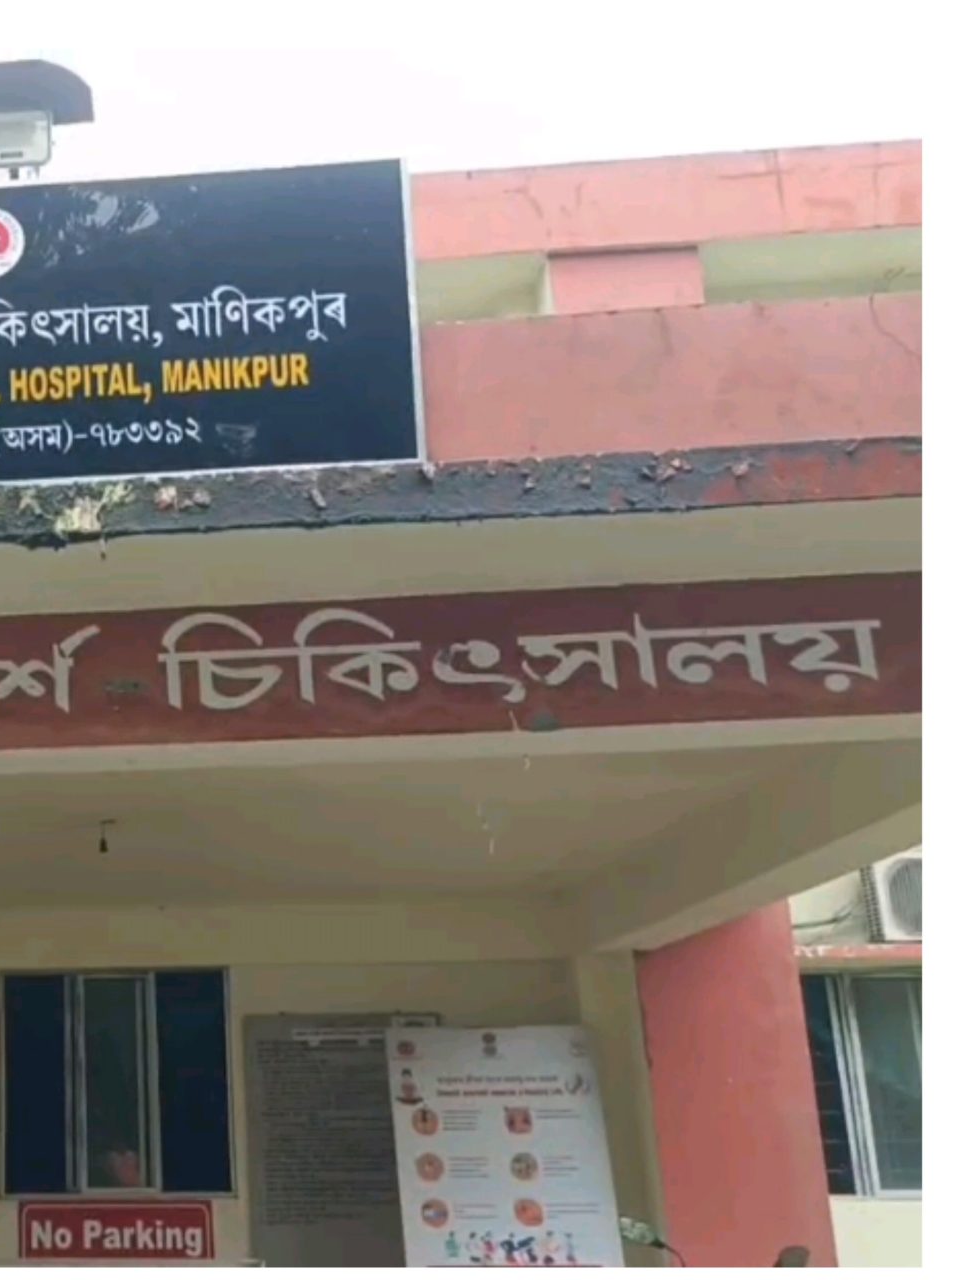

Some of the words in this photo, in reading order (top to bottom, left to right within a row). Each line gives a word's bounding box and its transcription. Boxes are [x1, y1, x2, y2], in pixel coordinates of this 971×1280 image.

[10, 362, 153, 404] HOSPITAL,
[162, 353, 310, 395] MANIKPUR
[31, 1209, 73, 1249] No
[83, 1209, 203, 1257] Parking
